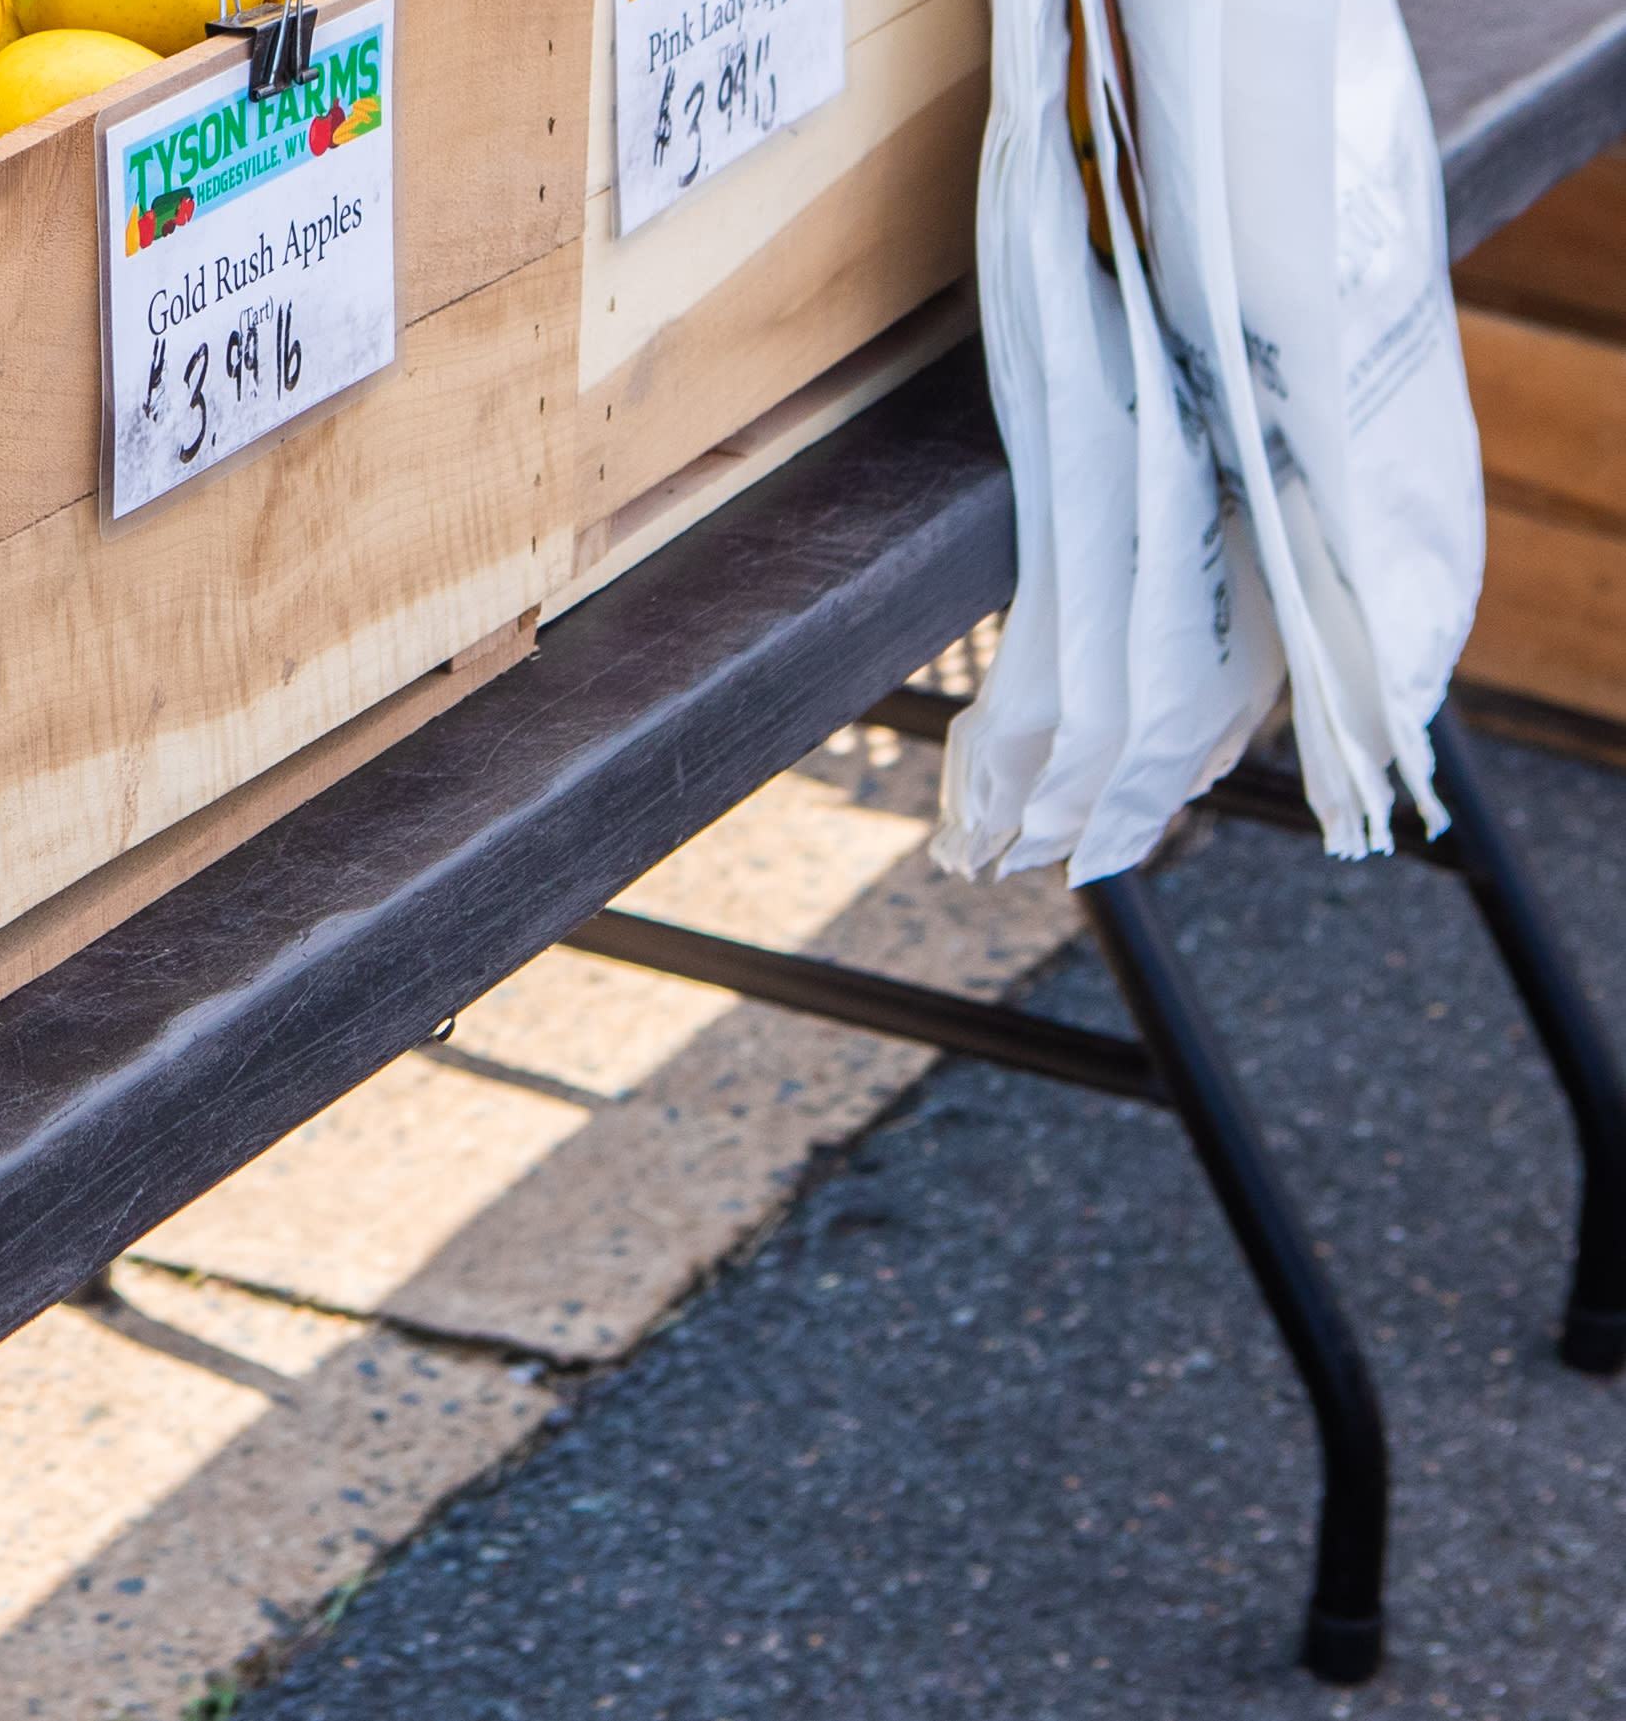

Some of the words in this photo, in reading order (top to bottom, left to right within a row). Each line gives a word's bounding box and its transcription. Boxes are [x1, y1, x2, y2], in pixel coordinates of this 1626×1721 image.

[649, 11, 694, 73] Pink
[130, 98, 248, 215] TYSON
[257, 36, 379, 140] FARMS
[285, 131, 306, 160] WV
[148, 265, 207, 335] Gold
[215, 233, 274, 303] Rush
[282, 195, 362, 270] Apples
[239, 296, 274, 337] (Tart)
[277, 298, 301, 400] lb
